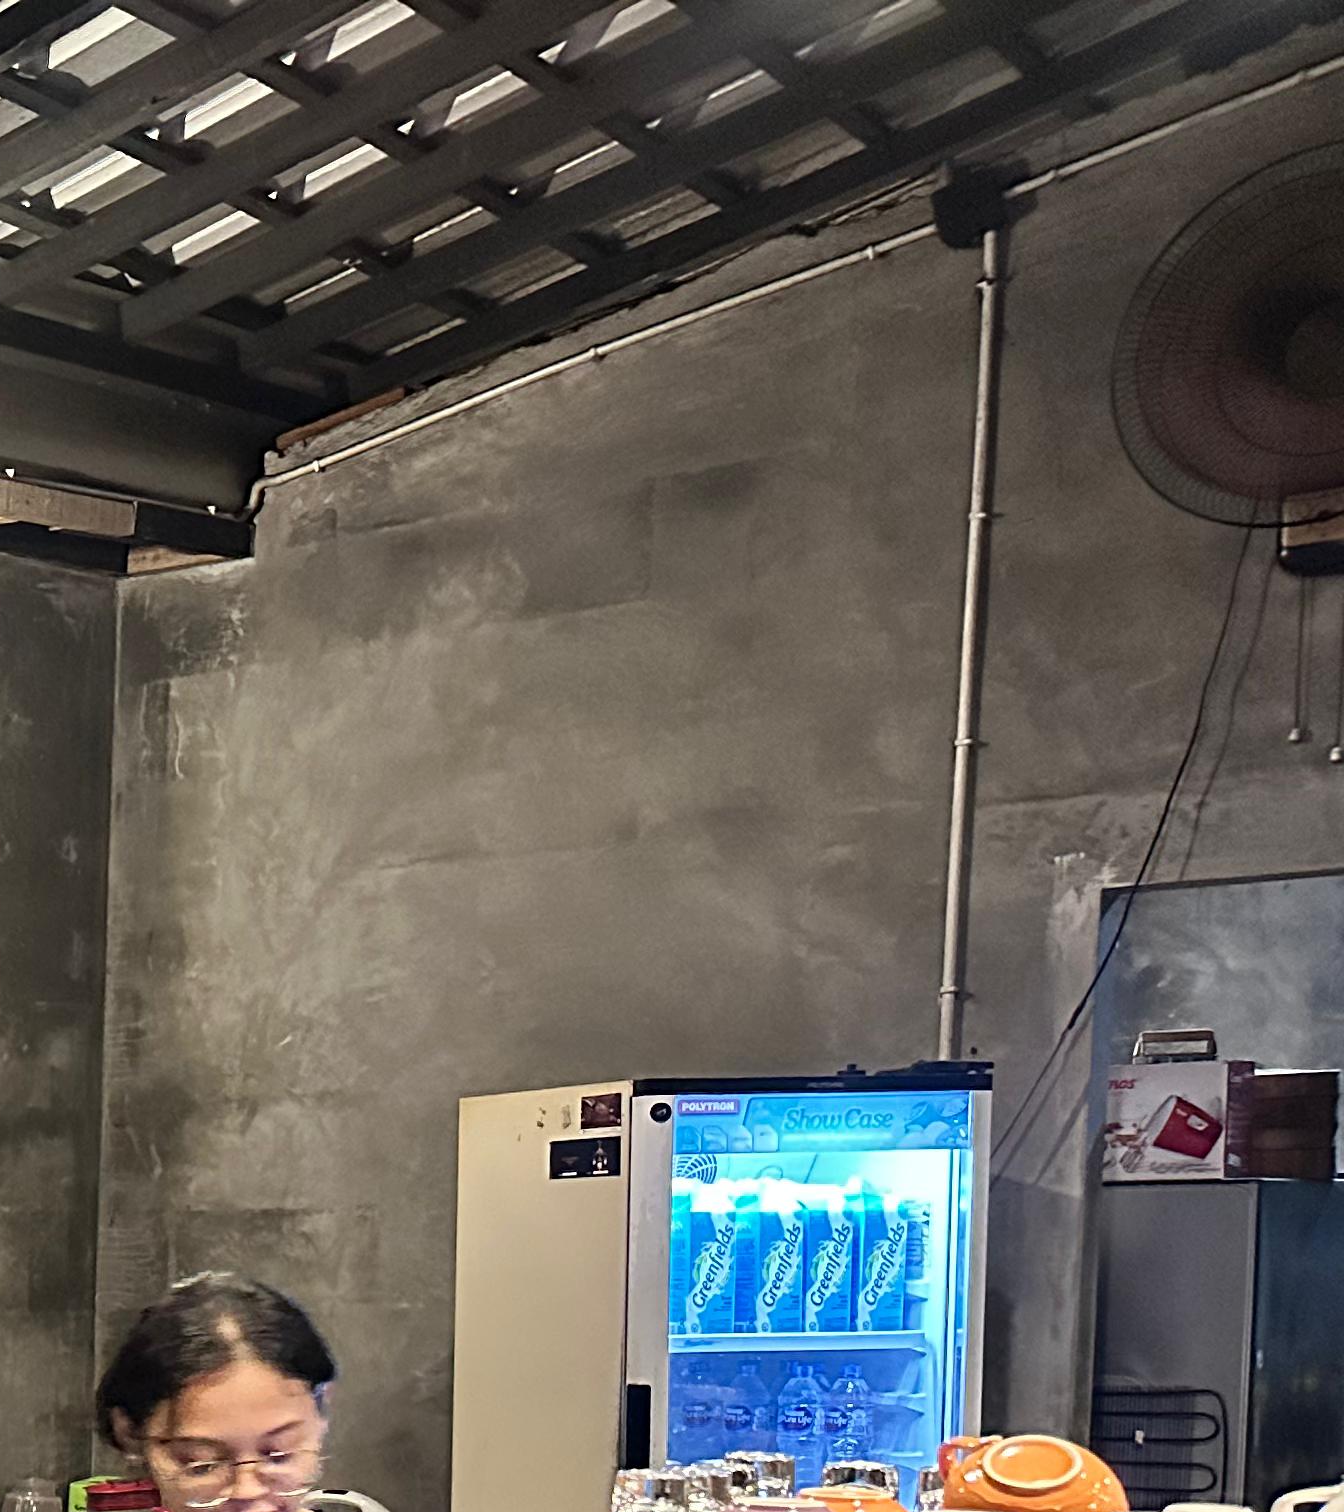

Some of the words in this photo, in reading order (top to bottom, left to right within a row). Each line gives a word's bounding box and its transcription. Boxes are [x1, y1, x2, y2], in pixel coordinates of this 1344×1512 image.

[681, 1101, 736, 1113] POLYTRON
[692, 1222, 735, 1309] Greenfields
[761, 1221, 801, 1308] Greenfields
[811, 1221, 852, 1308] Greenfields
[863, 1221, 906, 1307] Greenfields
